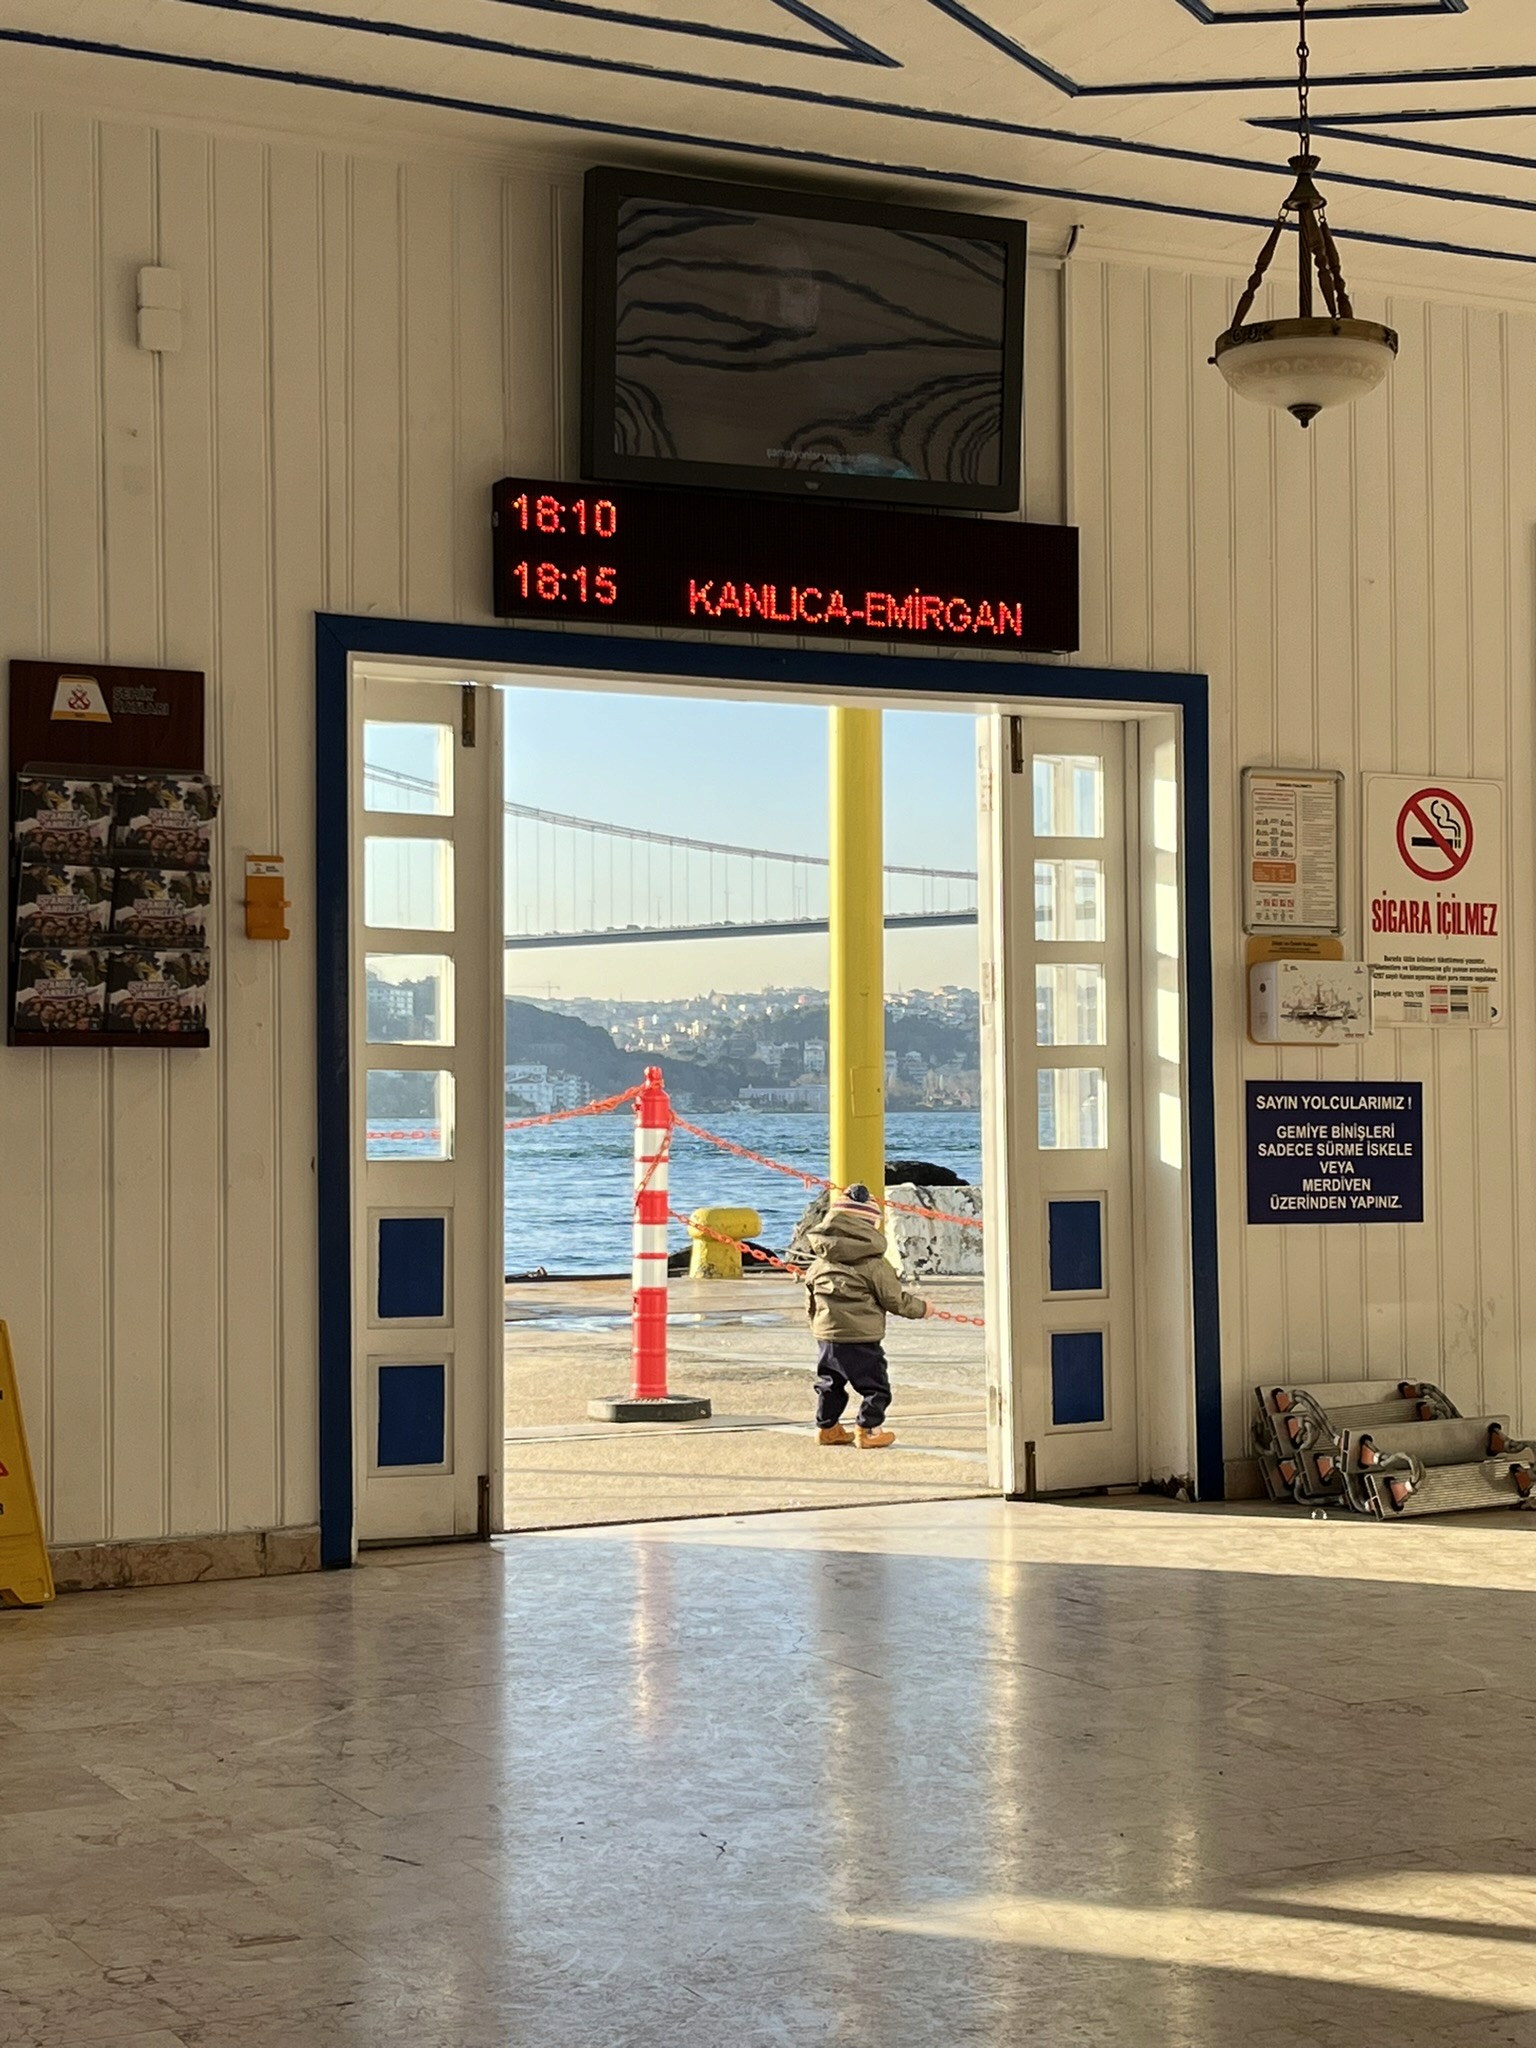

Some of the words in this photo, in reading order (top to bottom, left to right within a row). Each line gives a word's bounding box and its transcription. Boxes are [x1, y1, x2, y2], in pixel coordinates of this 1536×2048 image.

[512, 493, 617, 538] 18:10
[512, 560, 617, 605] 18:15
[688, 579, 1024, 636] KANLICA-EMİRGAN
[1372, 890, 1432, 934] SİGARA
[1436, 892, 1498, 940] İÇİLMEZ
[1256, 1096, 1298, 1110] SAYIN
[1301, 1096, 1405, 1110] YOLCULARIMIZ
[1276, 1122, 1328, 1139] GEMİYE
[1331, 1122, 1395, 1141] BİNİŞLERİ
[1257, 1143, 1314, 1156] SADECE
[1316, 1140, 1364, 1156] SÜRME
[1367, 1140, 1413, 1156] İSKELE
[1319, 1161, 1355, 1174] VEYA
[1302, 1175, 1371, 1191] MERDİVEN
[1270, 1194, 1346, 1210] ÜZERİNDEN
[1349, 1196, 1403, 1209] YAPINIZ.
